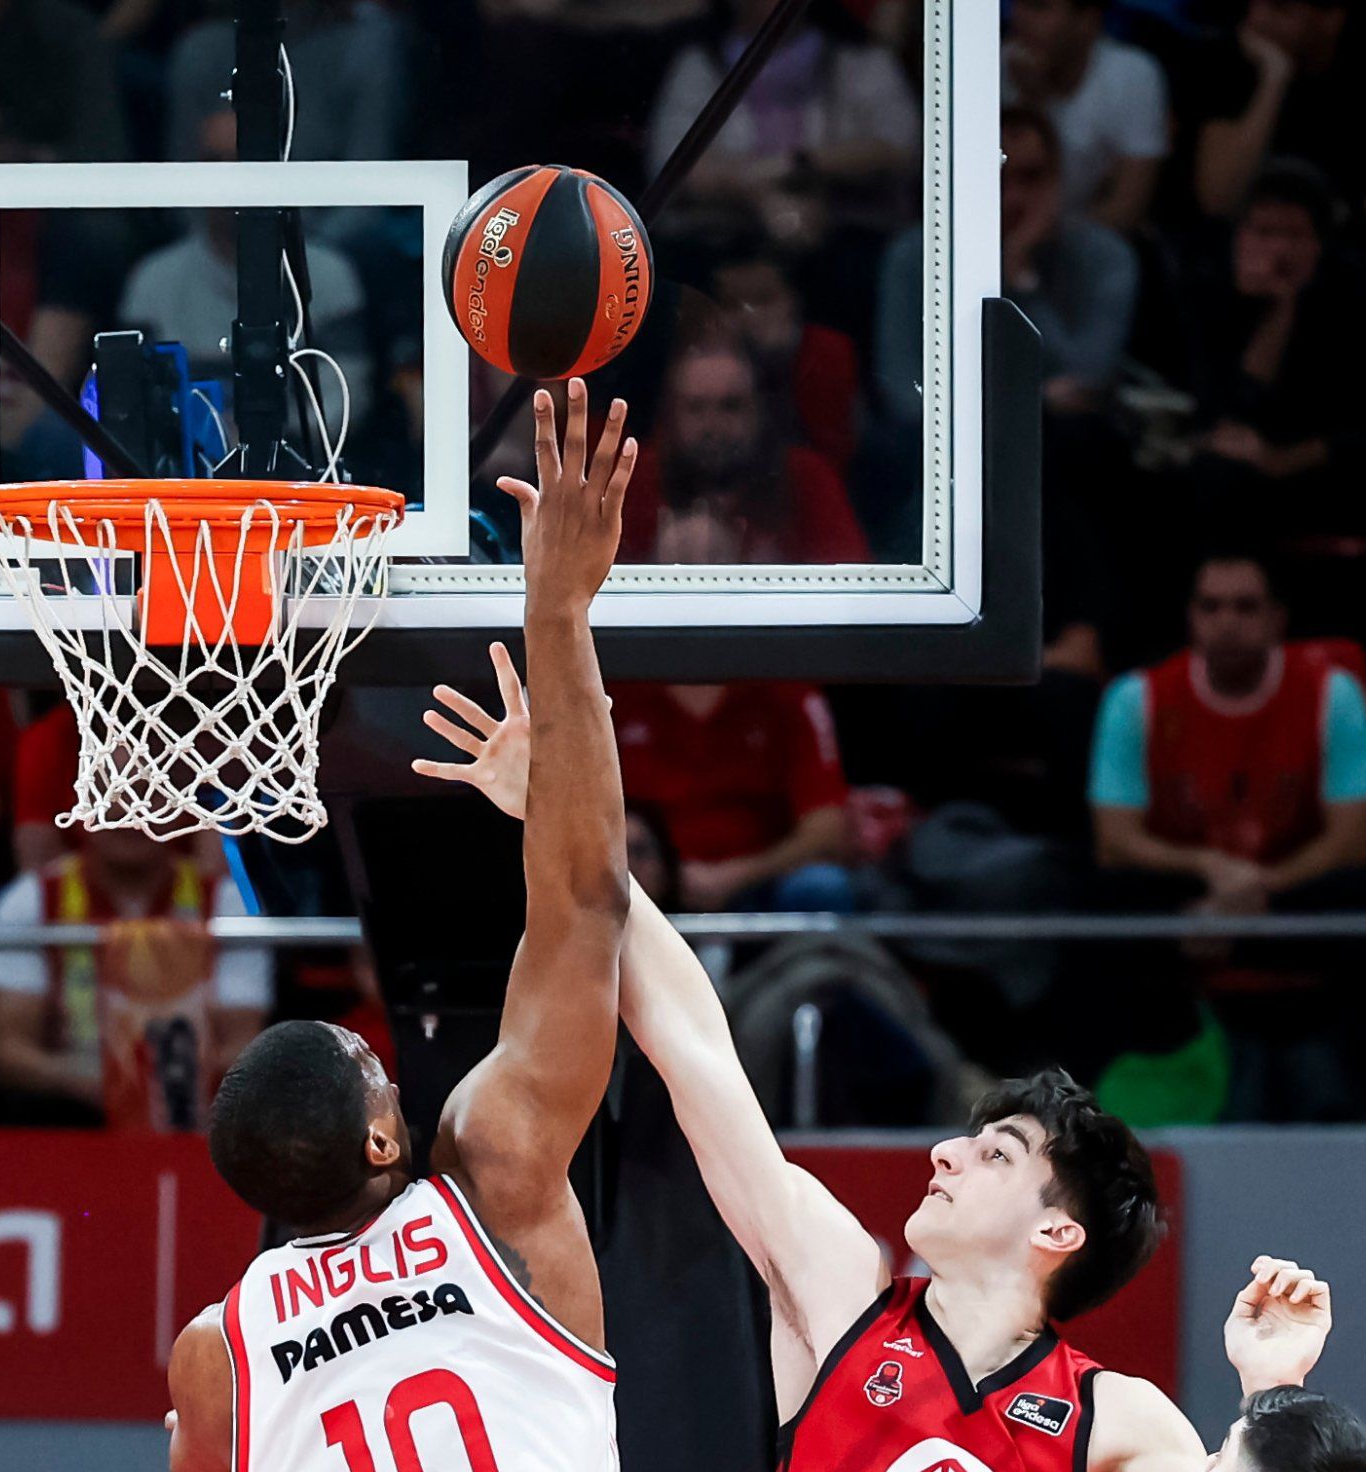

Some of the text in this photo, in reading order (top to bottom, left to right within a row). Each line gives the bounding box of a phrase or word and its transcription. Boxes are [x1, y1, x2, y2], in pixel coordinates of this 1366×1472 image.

[479, 208, 521, 259] liga
[468, 258, 490, 346] endes
[270, 1215, 449, 1324] INGLIS
[270, 1283, 475, 1384] PAMESA
